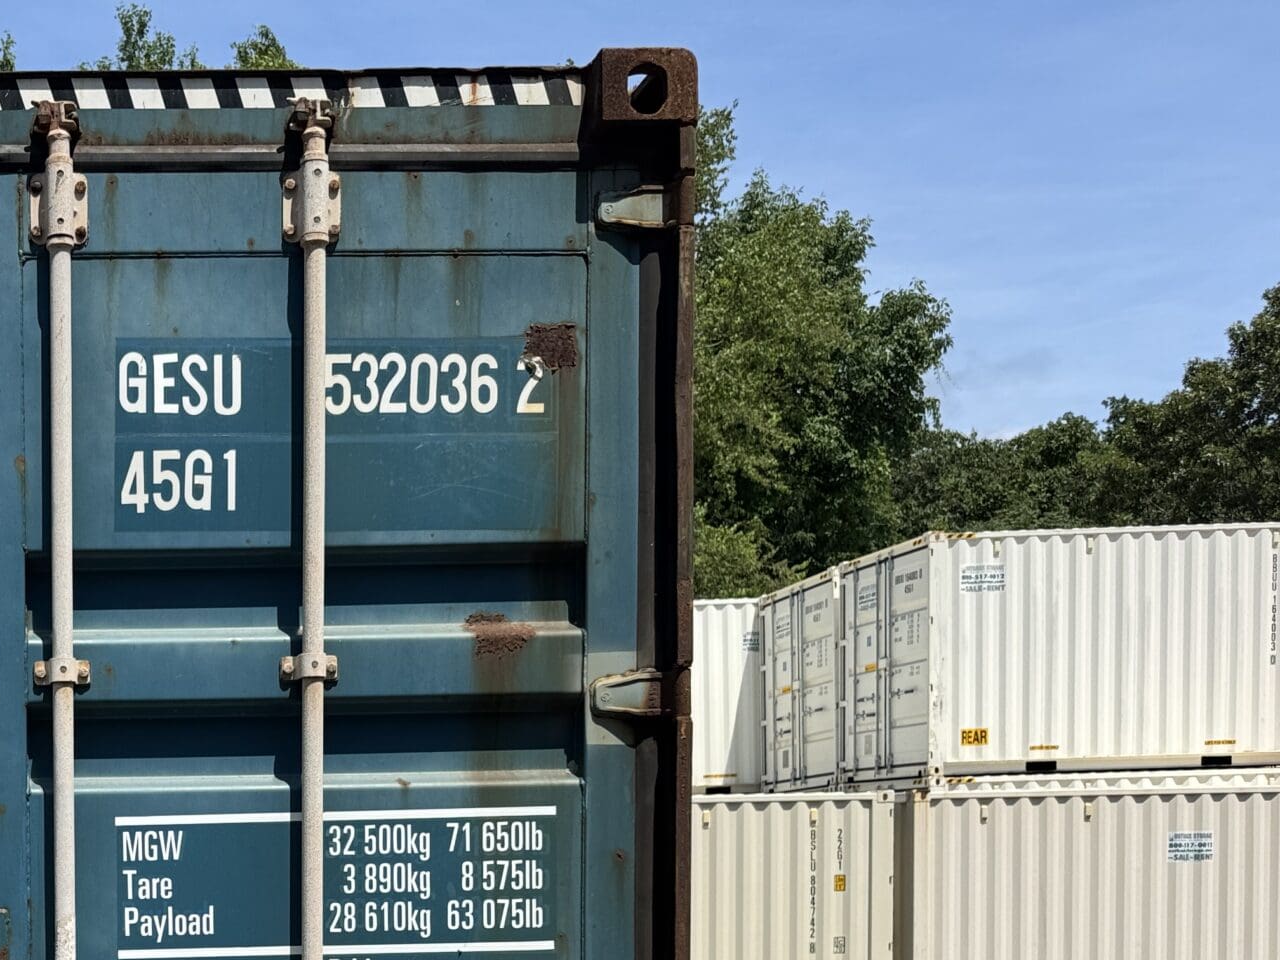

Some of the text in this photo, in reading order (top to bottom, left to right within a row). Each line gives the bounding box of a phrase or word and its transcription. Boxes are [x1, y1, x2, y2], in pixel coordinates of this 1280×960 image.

[119, 352, 545, 415] GESU 532036 2
[120, 449, 236, 513] 45G1
[961, 730, 987, 745] REAR
[122, 821, 543, 862] MGW 32 500kg 71 650lb
[122, 860, 543, 900] Tare 3 890kg 8 575lb
[124, 898, 543, 944] Payload 28 610kg 63 075lb
